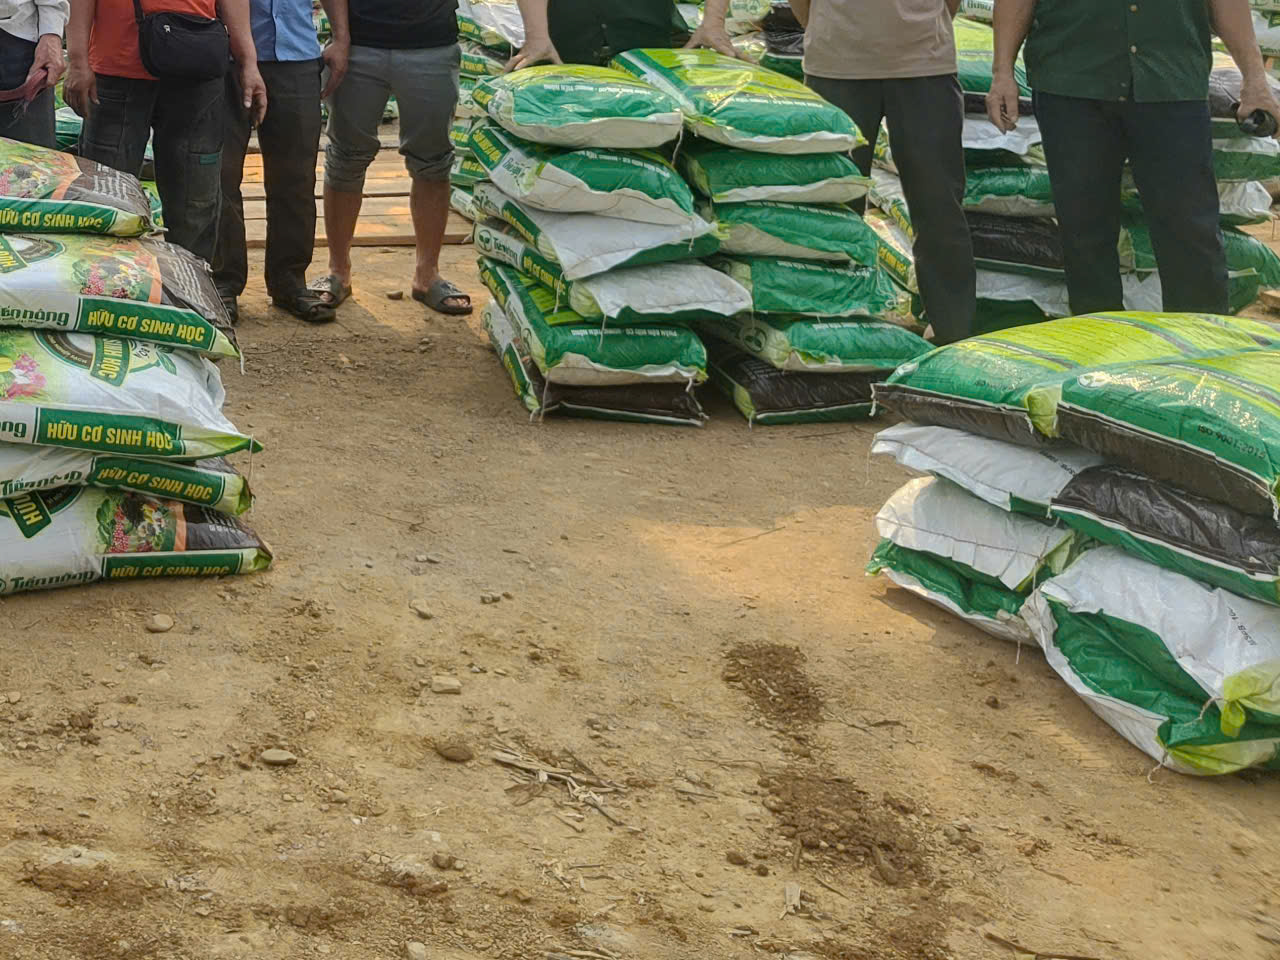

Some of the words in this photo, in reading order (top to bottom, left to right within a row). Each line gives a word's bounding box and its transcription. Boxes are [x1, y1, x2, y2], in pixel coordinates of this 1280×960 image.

[22, 210, 41, 227] CƠ
[42, 213, 74, 228] SINH
[88, 308, 115, 328] HỮU
[117, 315, 139, 331] CƠ
[140, 319, 175, 336] SINH
[177, 324, 206, 343] HỌC
[96, 357, 121, 380] HỌC
[47, 420, 79, 441] HỮU
[81, 425, 103, 443] CƠ
[106, 428, 142, 447] SINH
[145, 430, 174, 452] HỌC
[127, 471, 151, 486] CƠ
[149, 476, 185, 492] SINH
[185, 483, 214, 501] HỌC
